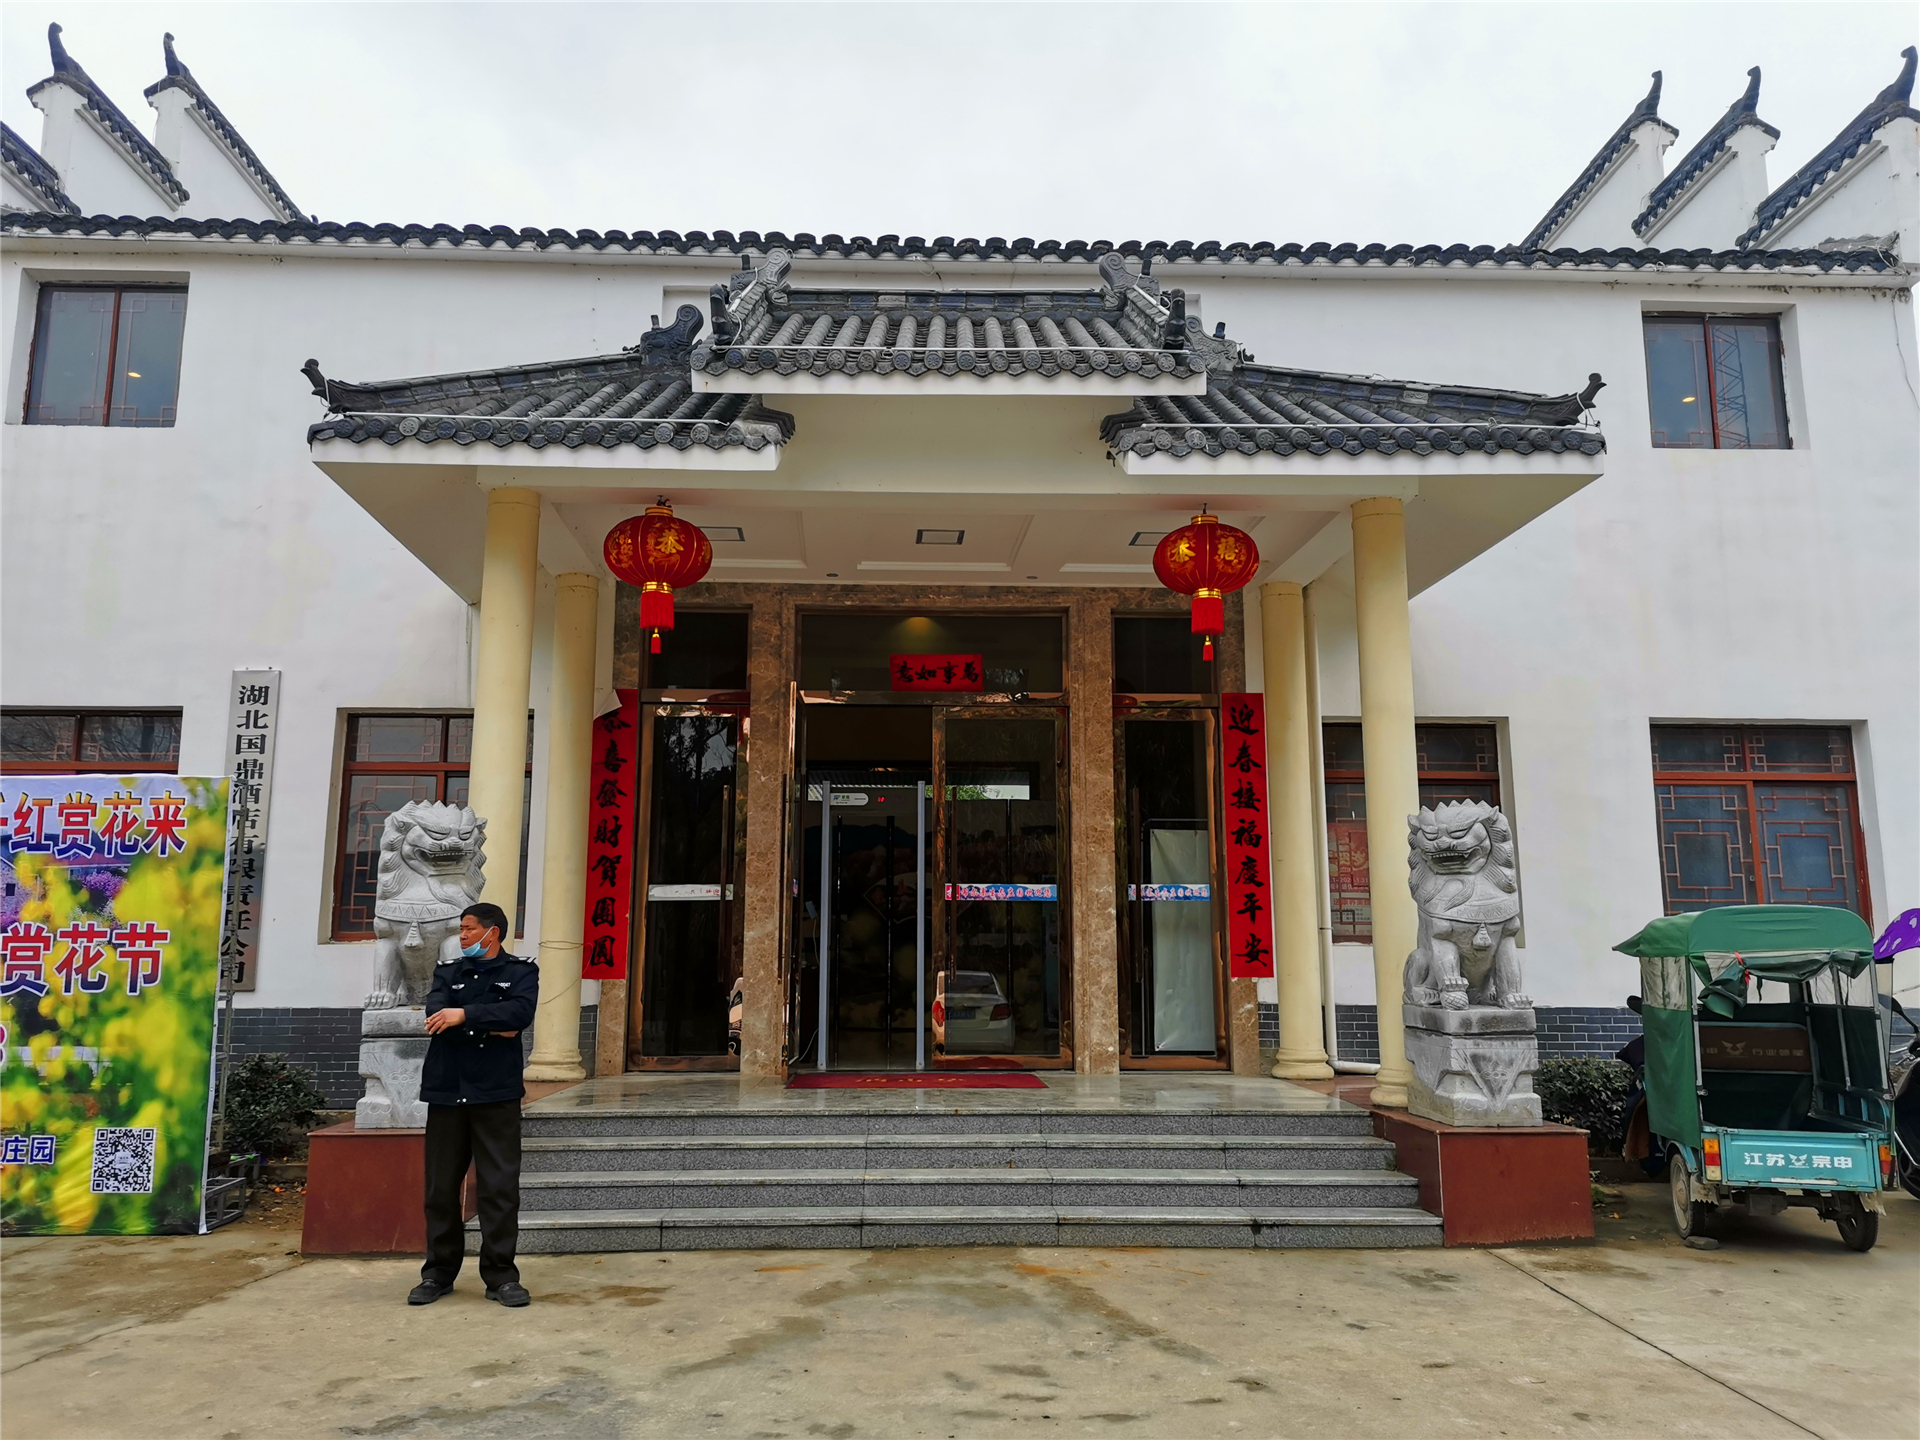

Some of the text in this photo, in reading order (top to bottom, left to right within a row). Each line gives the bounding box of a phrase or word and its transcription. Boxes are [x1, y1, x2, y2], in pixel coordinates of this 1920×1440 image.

[0, 789, 187, 858] 红赏花来
[0, 921, 170, 996] 赏花节
[0, 1135, 55, 1164] 庄园
[1744, 1152, 1852, 1169] 江苏 宗申
